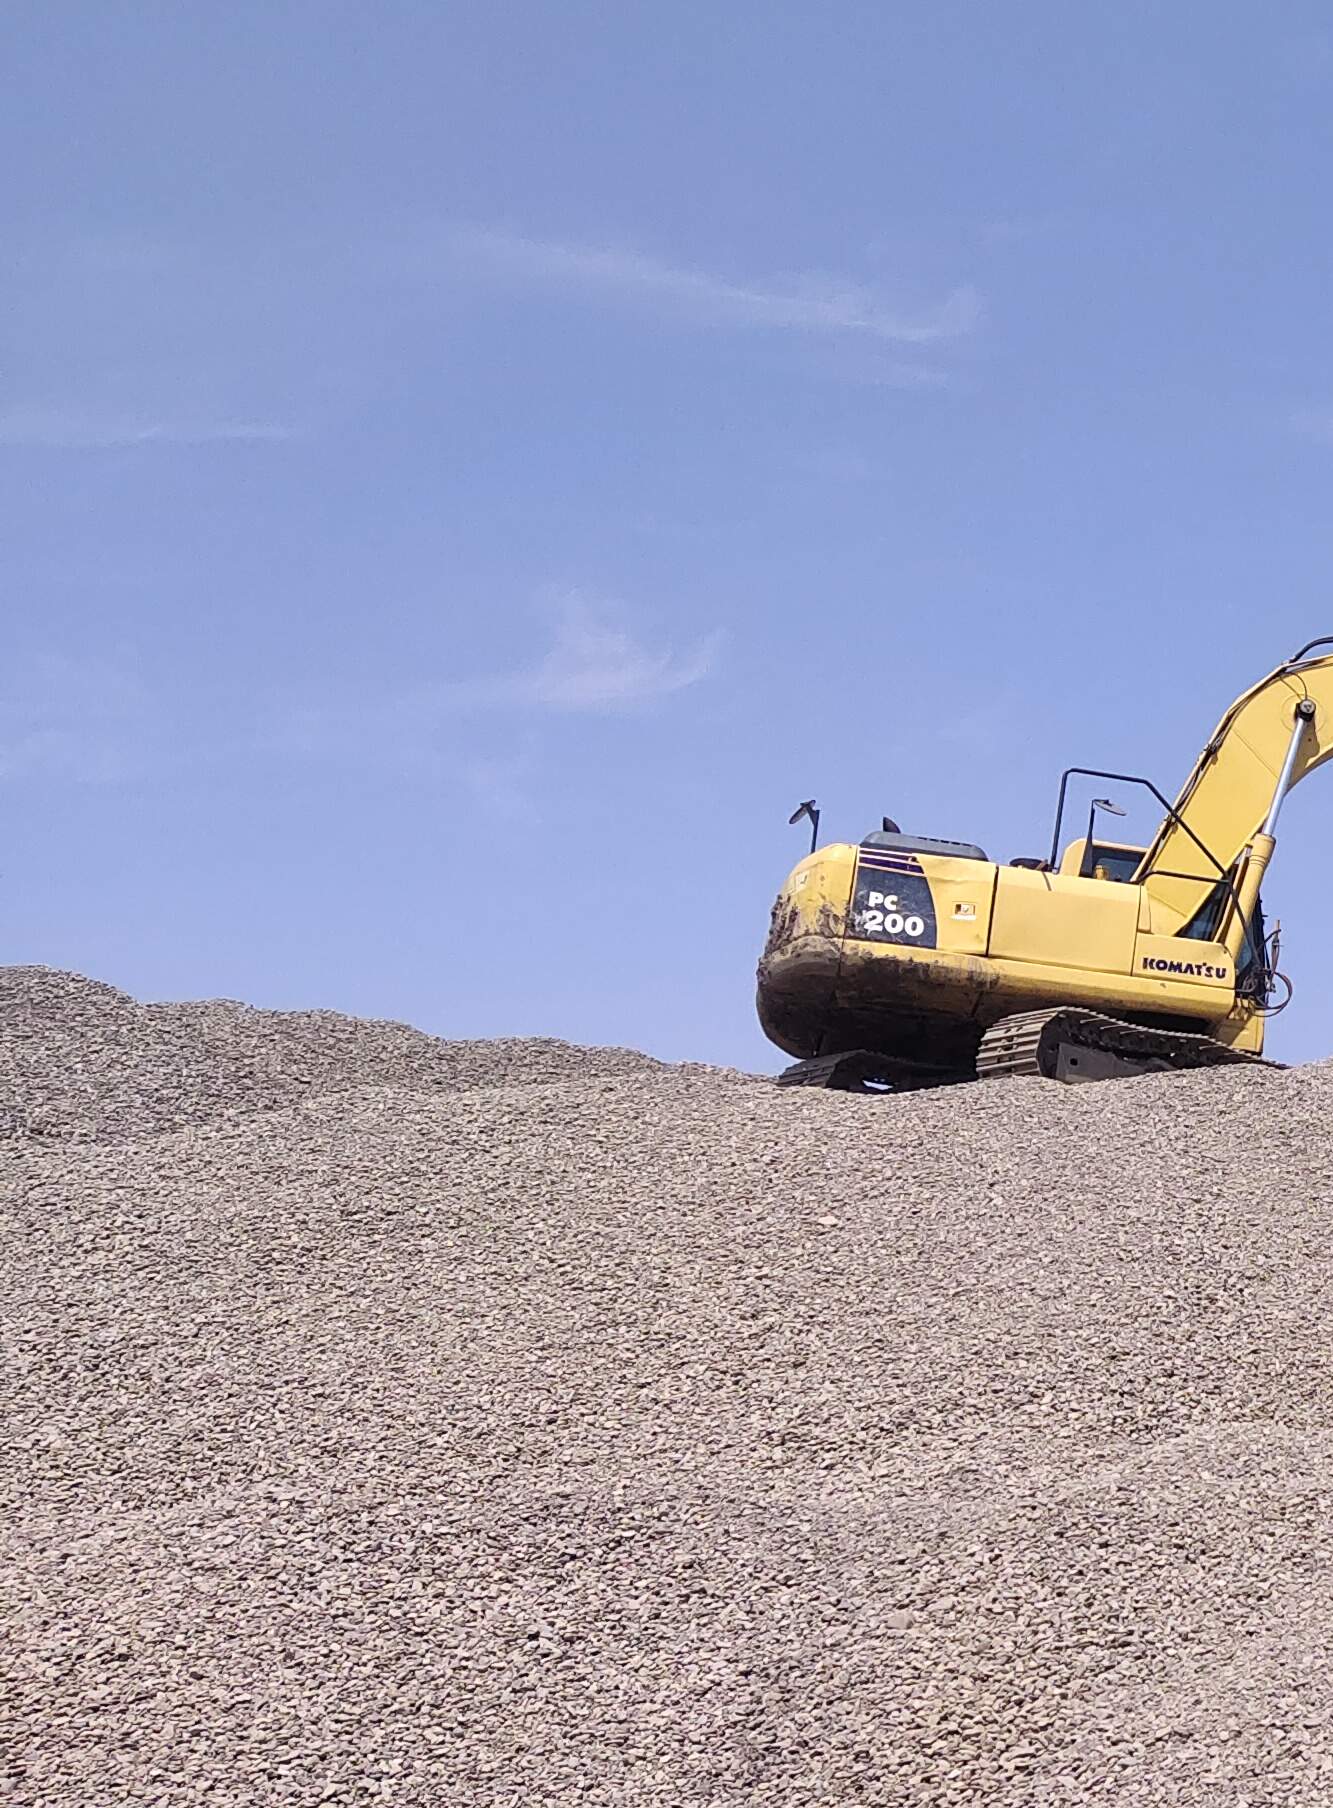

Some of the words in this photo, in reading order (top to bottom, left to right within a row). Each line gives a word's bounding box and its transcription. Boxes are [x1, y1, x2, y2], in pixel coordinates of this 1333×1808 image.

[868, 891, 899, 911] PC
[863, 910, 924, 937] 200
[1142, 957, 1227, 979] KOMATSU
